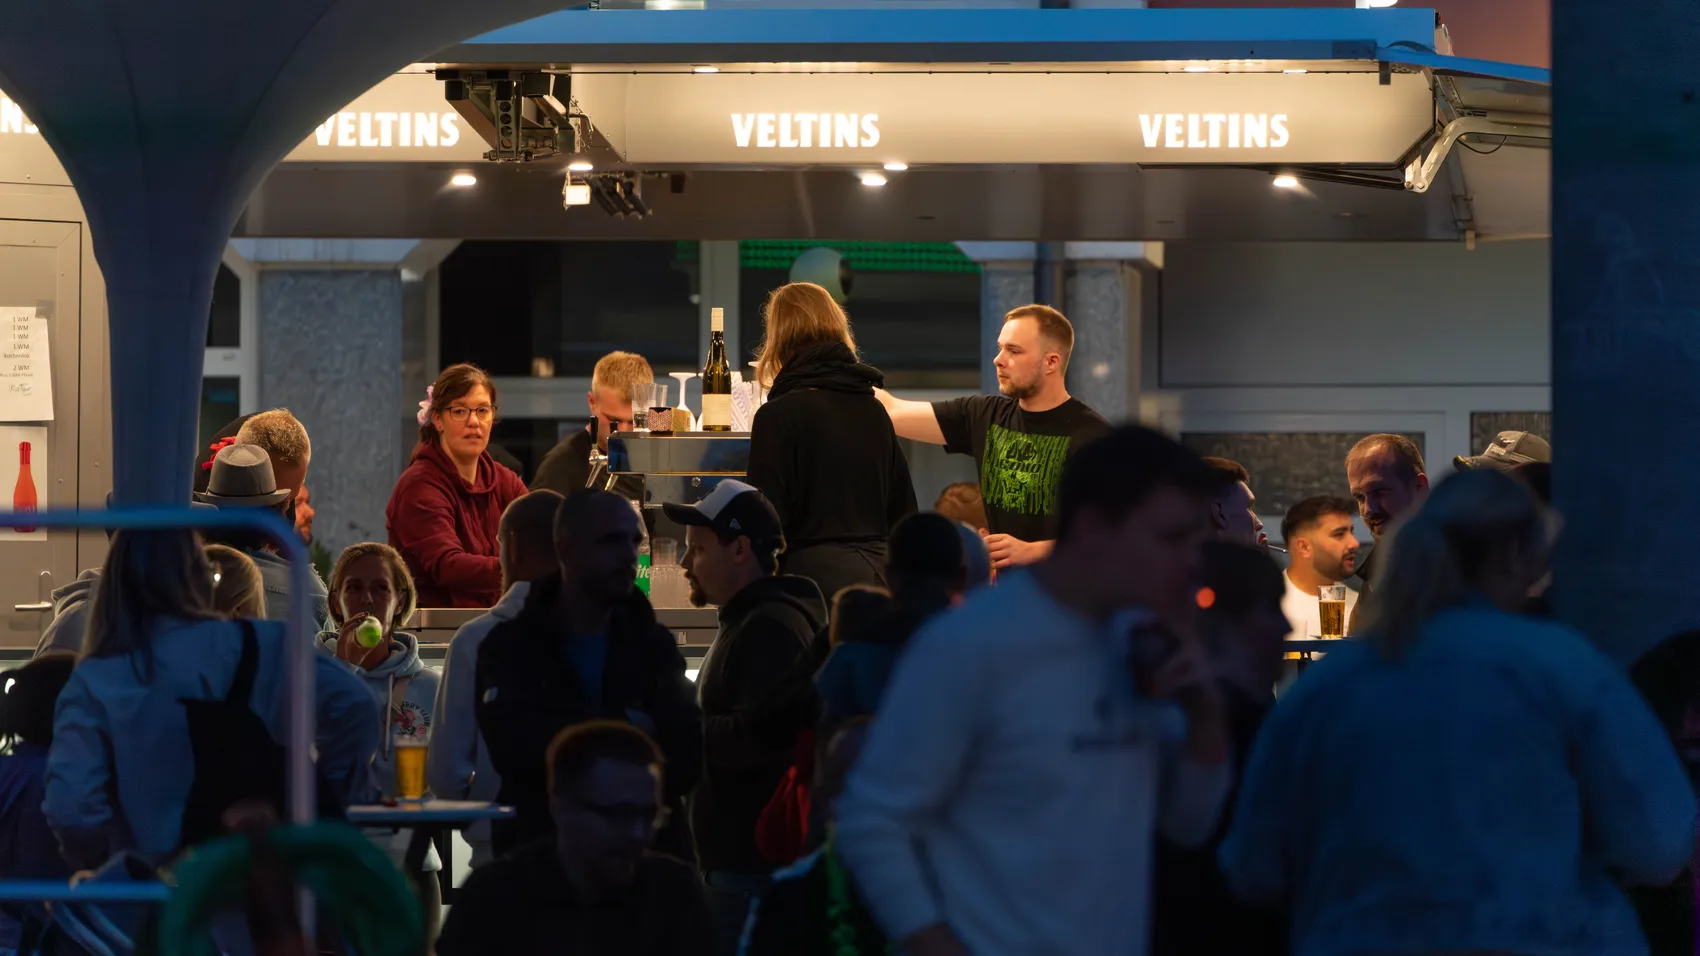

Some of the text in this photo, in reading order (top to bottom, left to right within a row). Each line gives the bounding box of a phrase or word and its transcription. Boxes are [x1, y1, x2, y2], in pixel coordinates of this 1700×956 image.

[314, 112, 460, 147] VELTINS
[731, 112, 880, 147] VELTINS
[1138, 112, 1289, 147] VELTINS
[636, 564, 650, 579] ite
